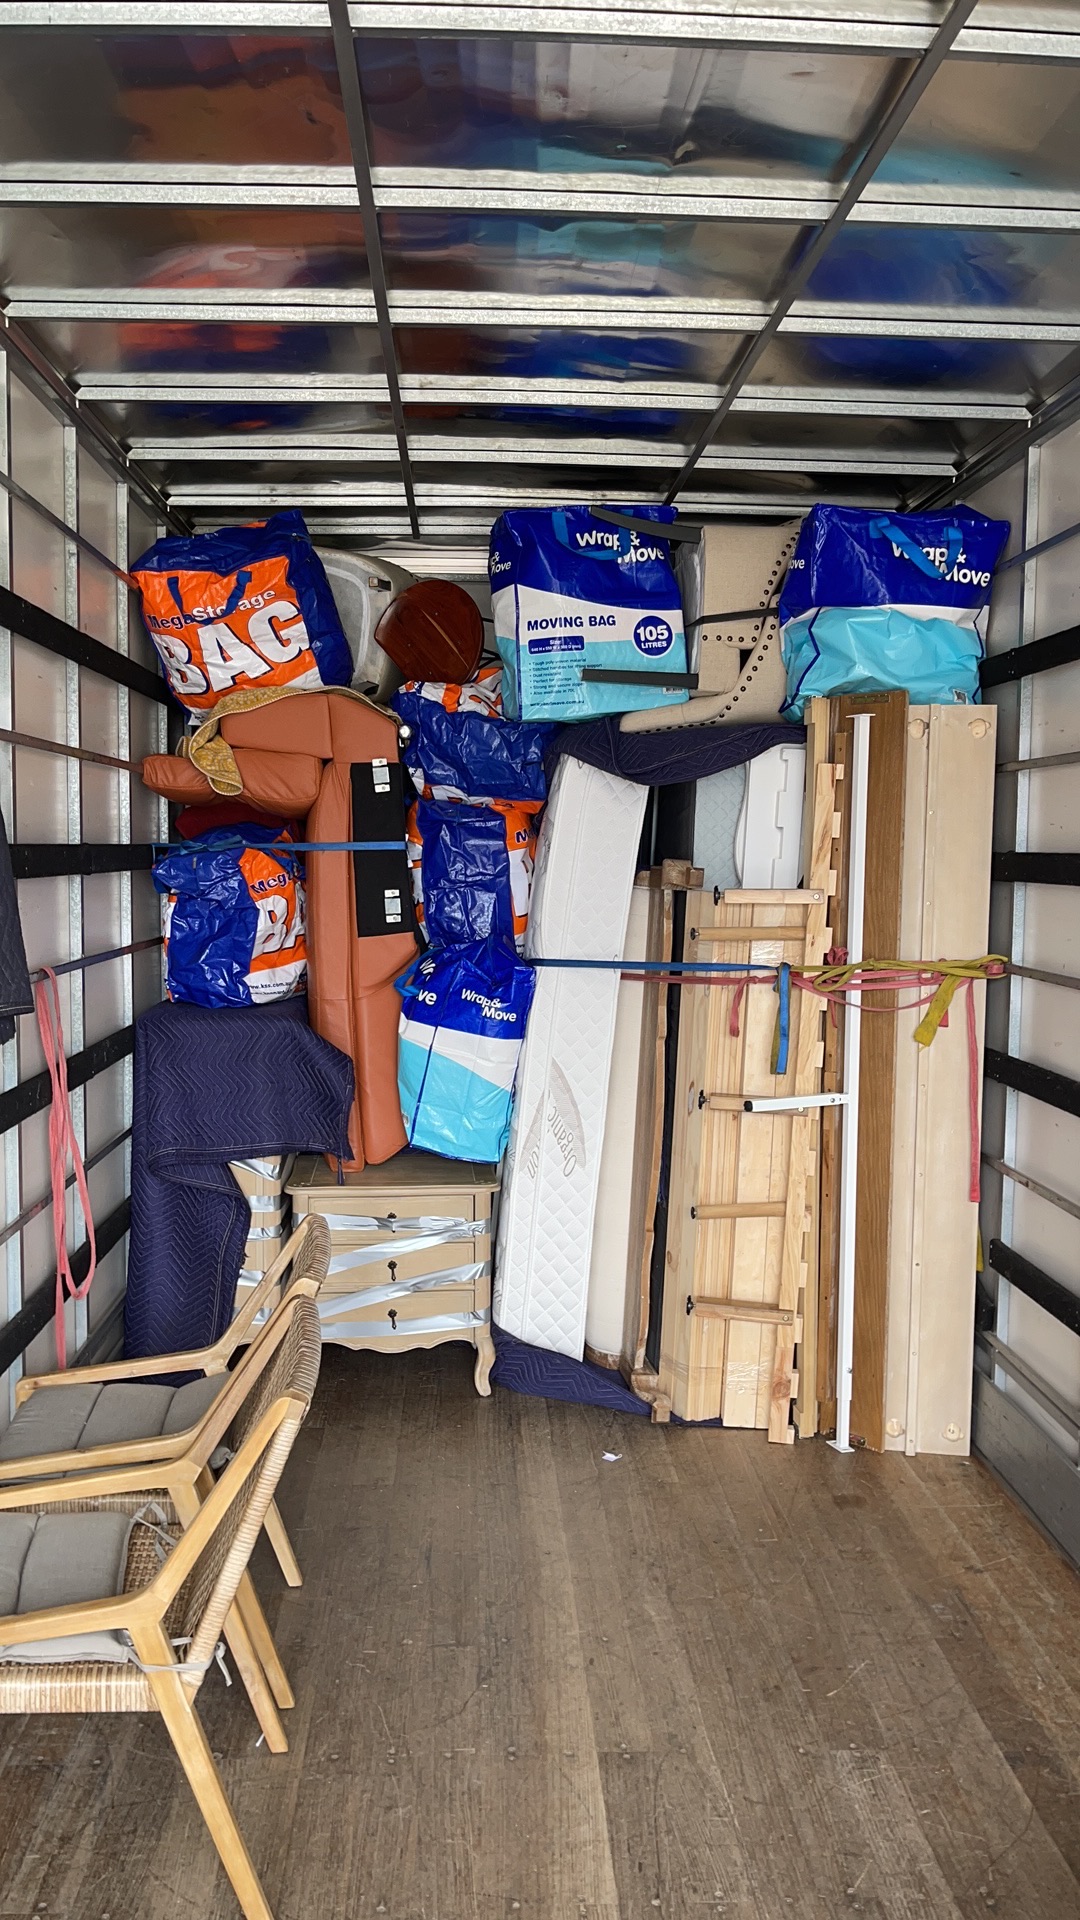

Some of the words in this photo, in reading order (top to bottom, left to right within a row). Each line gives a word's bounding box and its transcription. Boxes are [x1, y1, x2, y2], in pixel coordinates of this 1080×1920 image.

[789, 559, 805, 569] ove
[147, 590, 276, 630] MegaStoage
[527, 616, 584, 631] MOVING
[588, 615, 616, 627] BAG
[636, 625, 669, 641] 105
[150, 600, 310, 695] BAG
[641, 641, 667, 649] LITRES
[482, 1006, 517, 1022] Move
[547, 1106, 577, 1177] Organic
